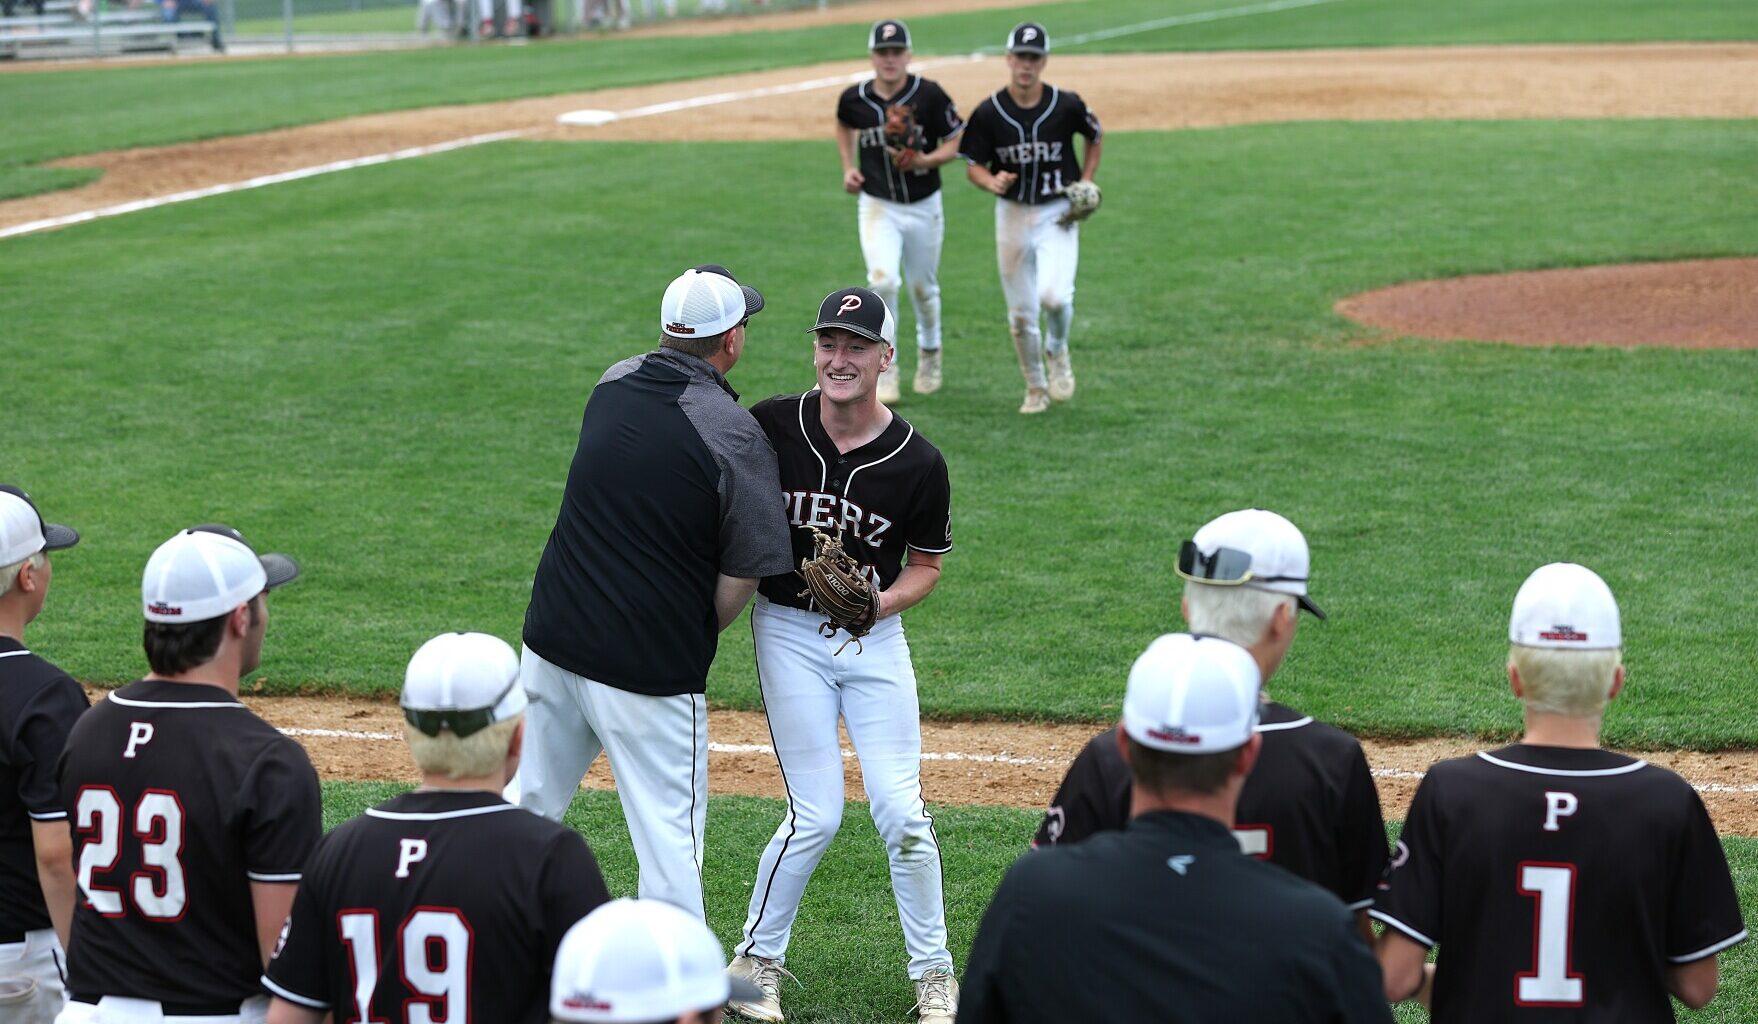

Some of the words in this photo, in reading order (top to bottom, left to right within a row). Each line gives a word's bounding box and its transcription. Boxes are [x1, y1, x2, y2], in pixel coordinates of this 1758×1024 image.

[881, 23, 898, 42] P
[1020, 26, 1039, 45] P
[996, 141, 1064, 164] PIERZ
[1040, 168, 1067, 197] 11
[836, 294, 863, 318] P
[824, 572, 851, 597] A1000
[122, 720, 155, 759] P
[1541, 790, 1580, 832] P
[73, 783, 191, 924] 23
[394, 836, 429, 879] P
[1512, 859, 1587, 1009] 1
[335, 904, 476, 1024] 19
